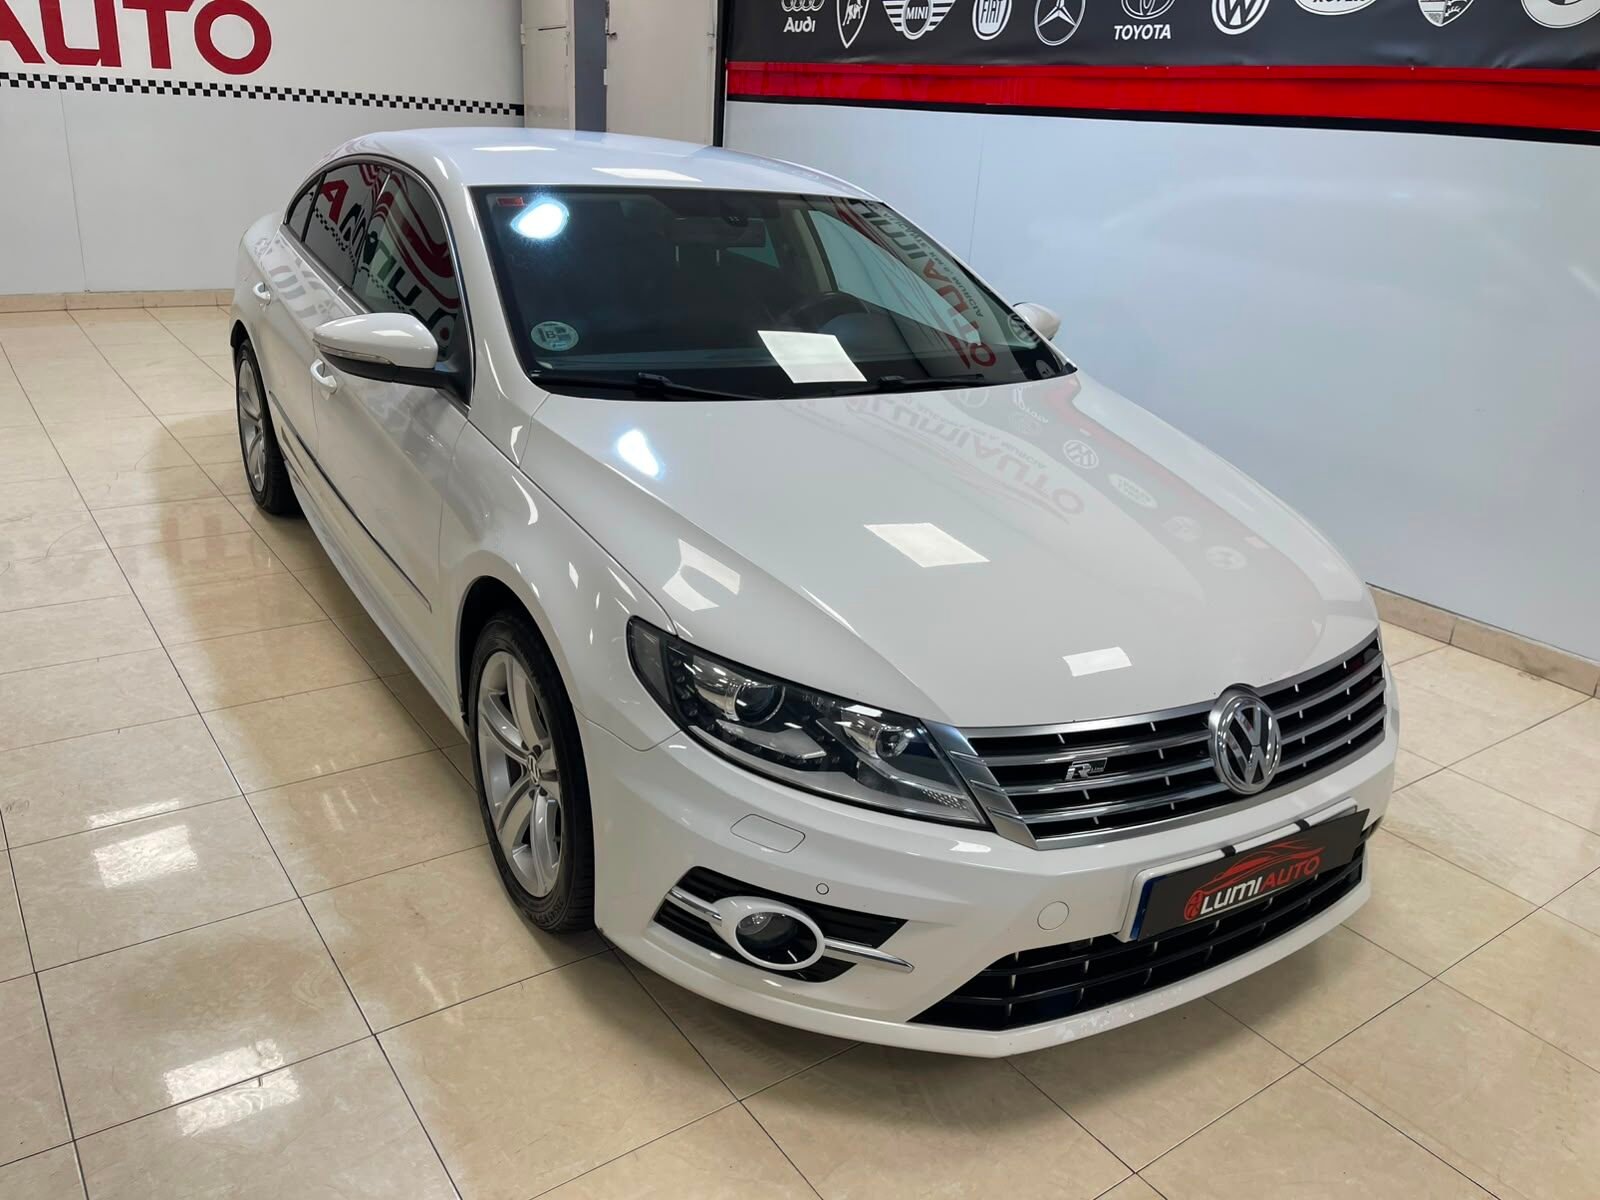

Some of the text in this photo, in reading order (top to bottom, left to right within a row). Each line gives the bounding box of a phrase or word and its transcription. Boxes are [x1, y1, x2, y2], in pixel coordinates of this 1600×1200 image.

[905, 6, 929, 19] MINI
[783, 16, 816, 32] Audi
[1113, 24, 1171, 40] TOYOTA
